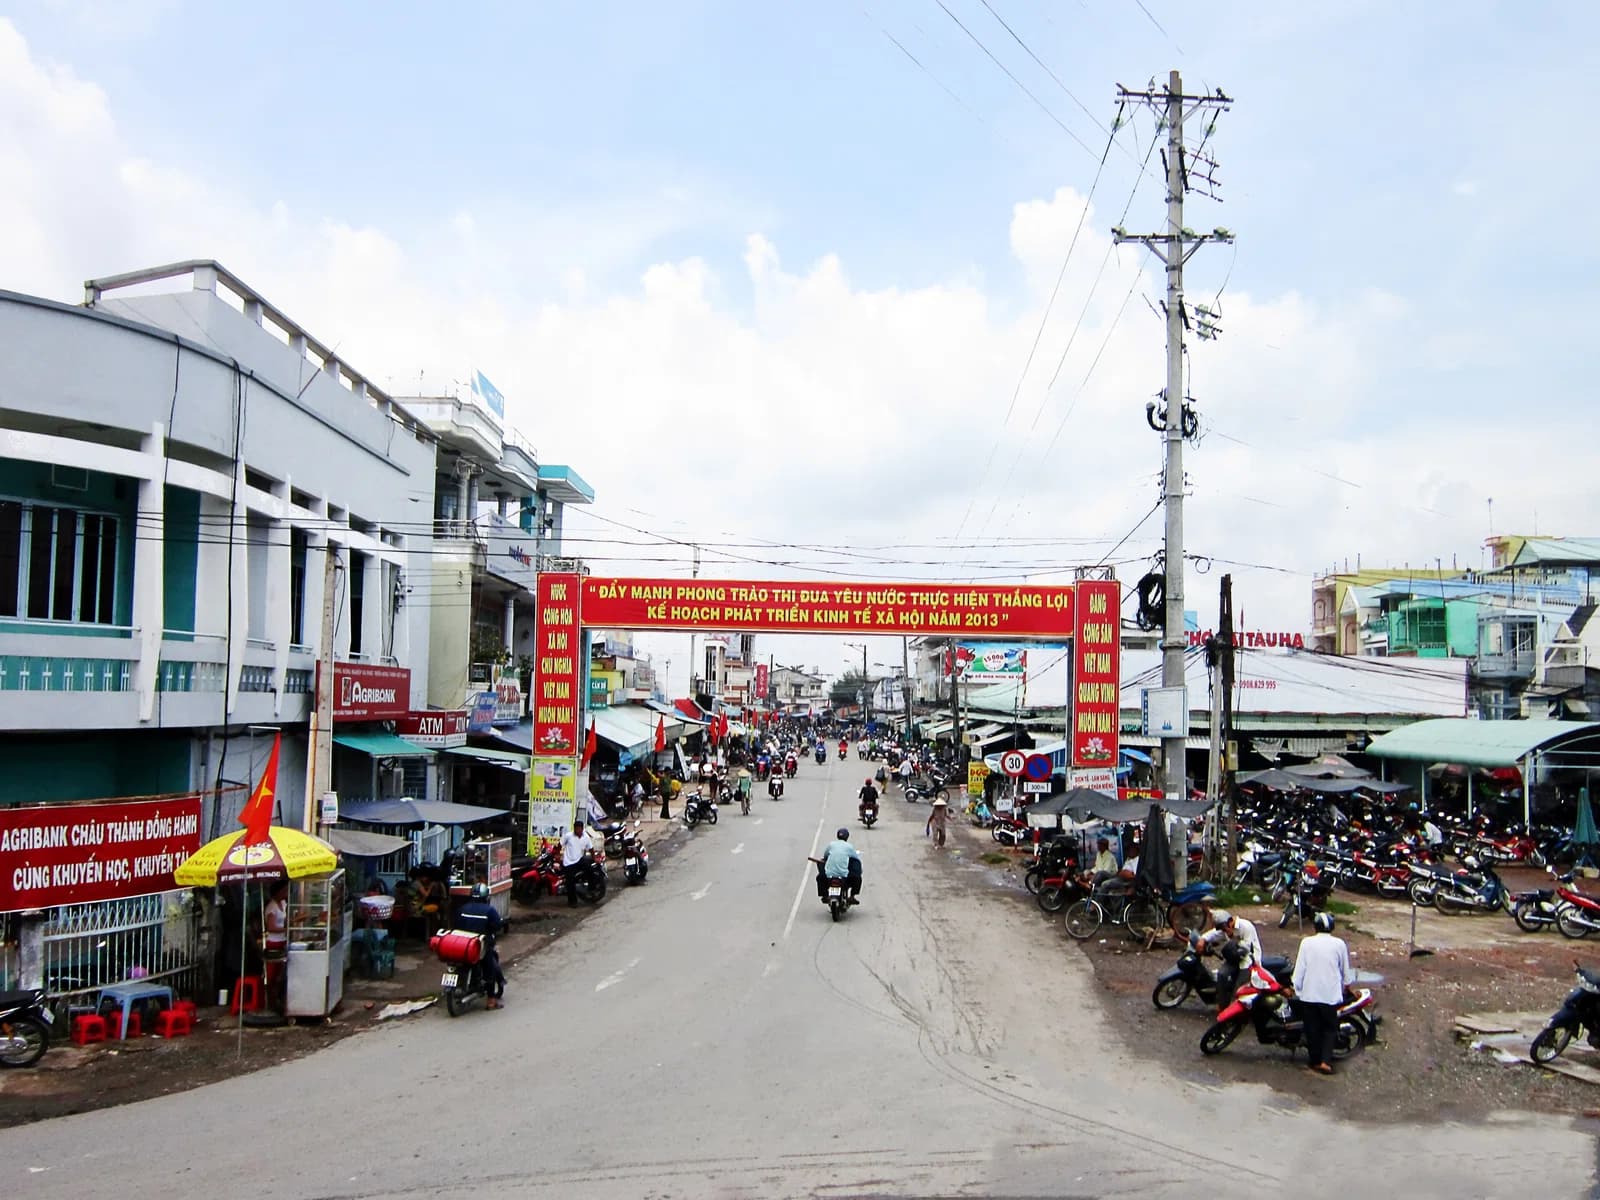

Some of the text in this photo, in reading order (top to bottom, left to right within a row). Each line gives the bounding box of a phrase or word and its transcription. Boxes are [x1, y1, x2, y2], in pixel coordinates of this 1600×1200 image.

[599, 579, 627, 599] ĐẨY
[631, 585, 673, 604] MẠNH
[676, 586, 726, 601] PHONG
[730, 585, 769, 602] TRÀO
[772, 589, 797, 603] THI
[799, 590, 829, 604] ĐUA
[833, 587, 863, 604] YÊU
[866, 588, 906, 605] NƯỚC
[910, 590, 950, 610] THỰC
[954, 590, 989, 611] HIỆN
[993, 588, 1043, 608] THẮNG
[1046, 592, 1068, 613] LỢI
[543, 604, 560, 629] CỘNG
[647, 600, 667, 620] KẾ
[671, 606, 720, 624] HOẠCH
[724, 604, 763, 622] PHÁT
[766, 602, 809, 623] TRIỂN
[813, 609, 849, 623] KINH
[853, 605, 872, 625] TẾ
[876, 607, 895, 625] XÃ
[900, 609, 925, 630] HỘI
[928, 609, 961, 626] NĂM
[965, 613, 998, 627] 2013
[556, 629, 568, 654] HỘI
[1083, 618, 1113, 648] CỘNG SẢN
[541, 652, 553, 675] CHỦ
[1083, 648, 1111, 677] VIỆT NAM
[543, 679, 556, 703] VIỆT
[556, 682, 570, 699] NAM
[1078, 682, 1116, 704] QUANG VINH
[418, 717, 443, 735] ATM
[455, 716, 466, 733] ATM
[556, 704, 571, 724] NĂM
[1096, 709, 1111, 733] NĂM
[1009, 757, 1021, 769] 30
[0, 810, 198, 852] AGRIBANK CHÂU THÀNH ĐỒNG HÀNH
[13, 861, 50, 891] CÙNG
[53, 852, 103, 887] KHUYẾN
[106, 858, 132, 887] HỌC,
[134, 844, 174, 878] KHUYẾN
